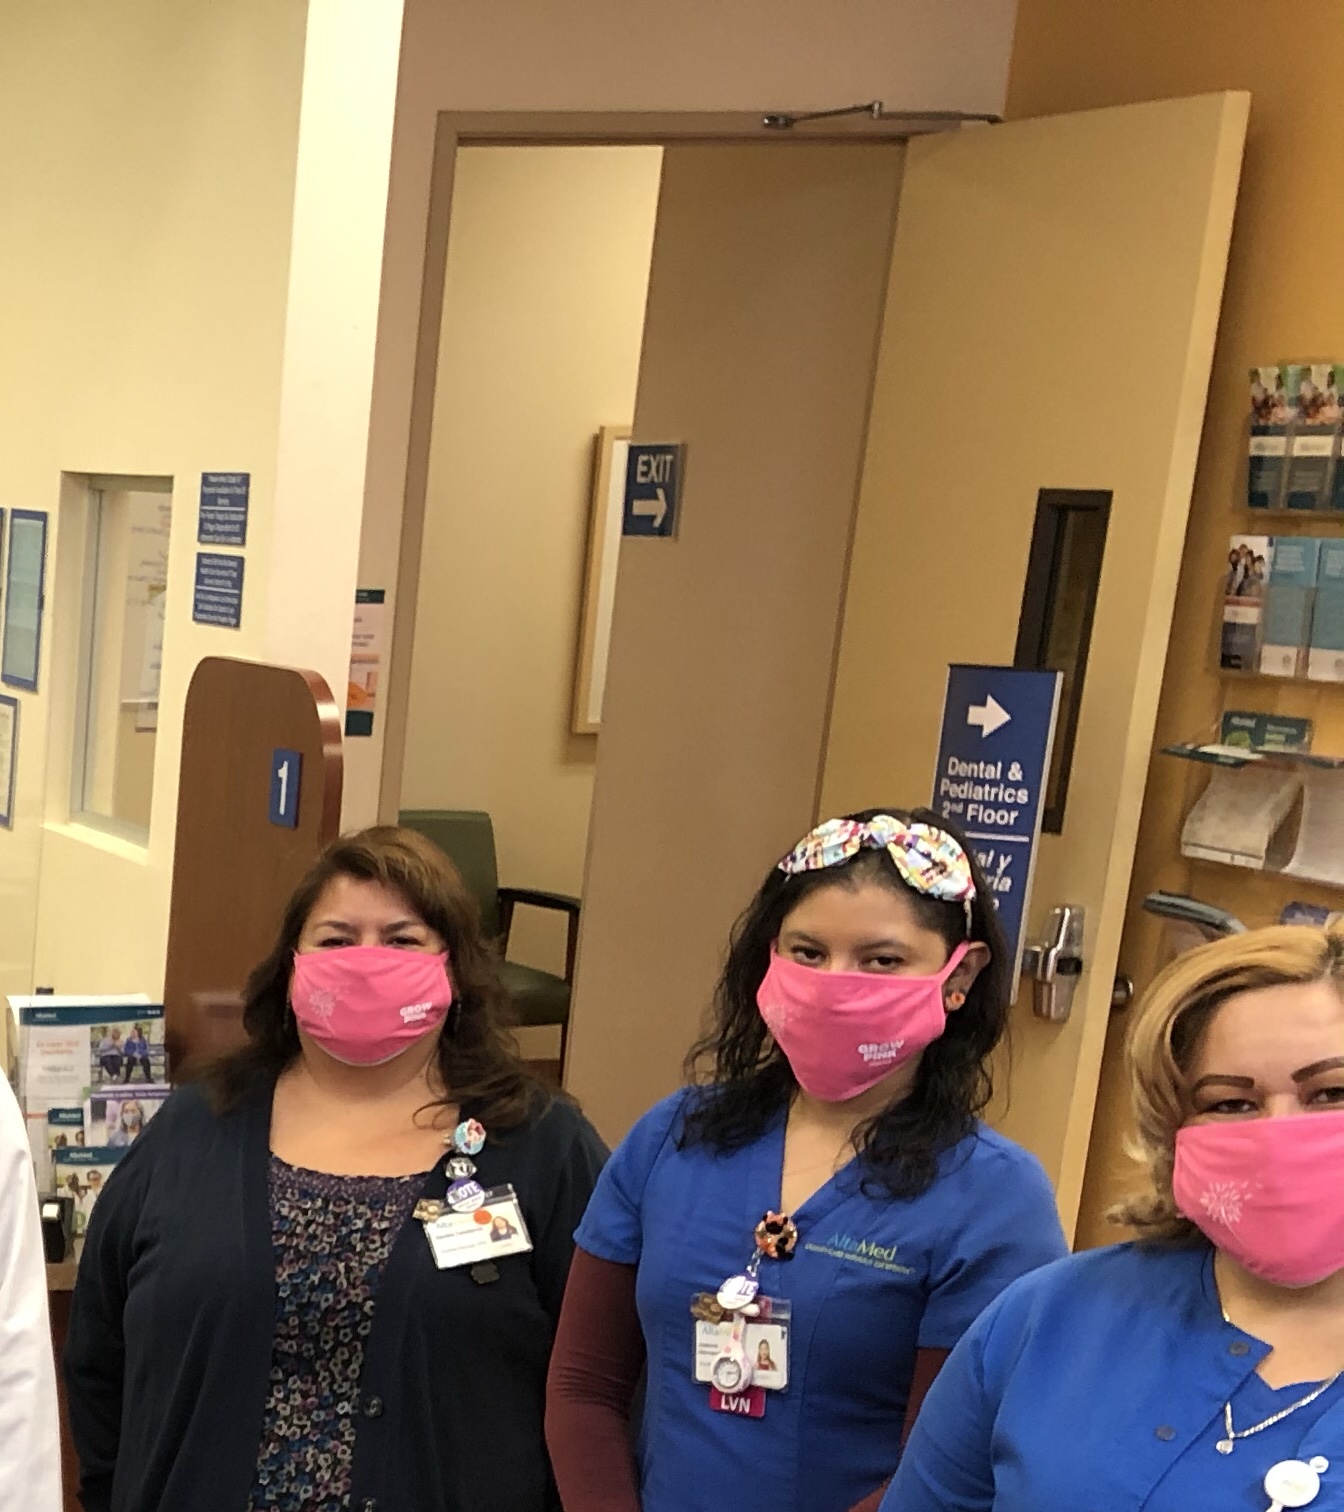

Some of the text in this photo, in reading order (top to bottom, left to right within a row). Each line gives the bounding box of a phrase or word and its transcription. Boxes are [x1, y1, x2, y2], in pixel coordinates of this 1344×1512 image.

[636, 454, 673, 483] EXIT
[947, 756, 1023, 782] Dental &
[277, 760, 289, 816] 1
[940, 777, 1029, 805] Pediatrics
[941, 801, 1019, 826] 2nd Floor
[858, 1040, 904, 1054] GROW
[826, 1232, 897, 1262] AltaMed
[720, 1394, 751, 1414] LVN
